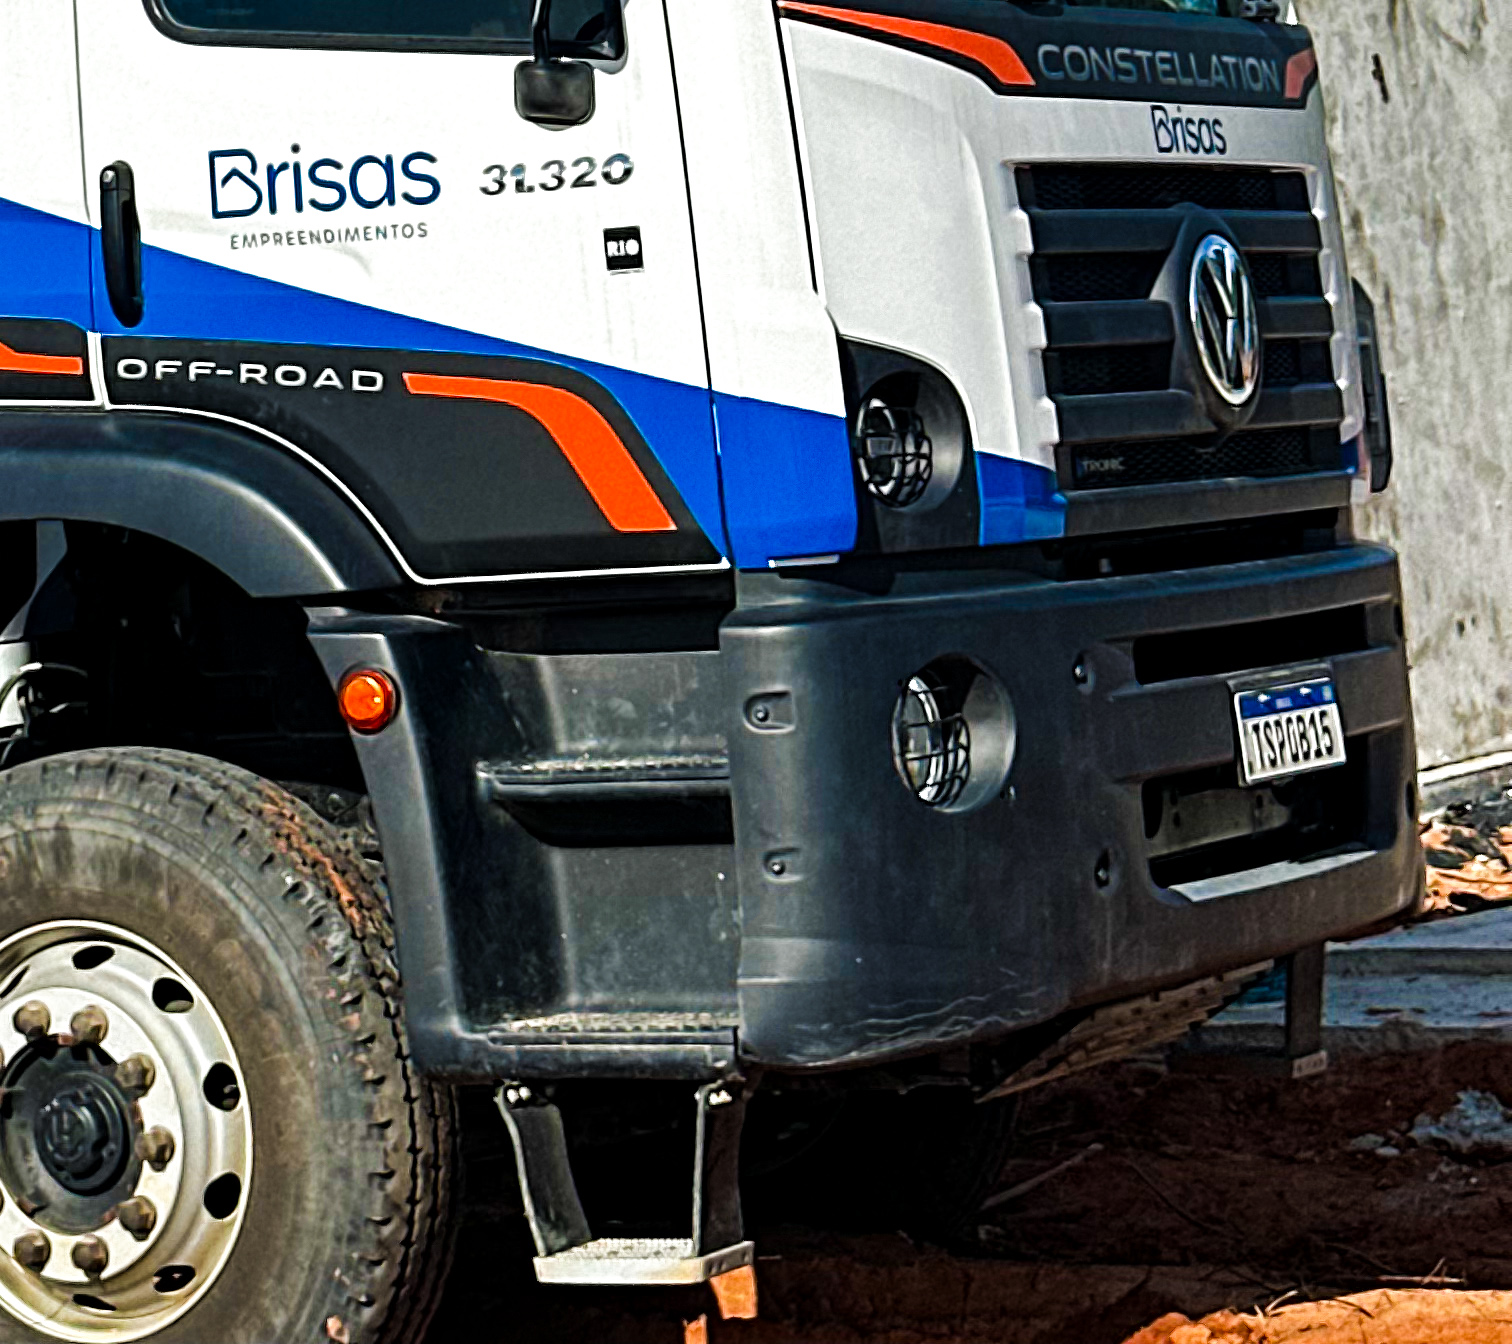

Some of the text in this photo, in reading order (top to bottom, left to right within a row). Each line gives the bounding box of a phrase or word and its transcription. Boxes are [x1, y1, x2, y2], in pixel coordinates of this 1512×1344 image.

[1037, 43, 1281, 93] CONSTELLATION
[1150, 104, 1227, 155] Brisas
[207, 143, 442, 220] Brisas
[478, 152, 635, 197] 31.320
[229, 221, 429, 251] EMPREENDIMENTOS
[605, 237, 641, 259] RIO
[116, 357, 385, 393] OFF-ROAD
